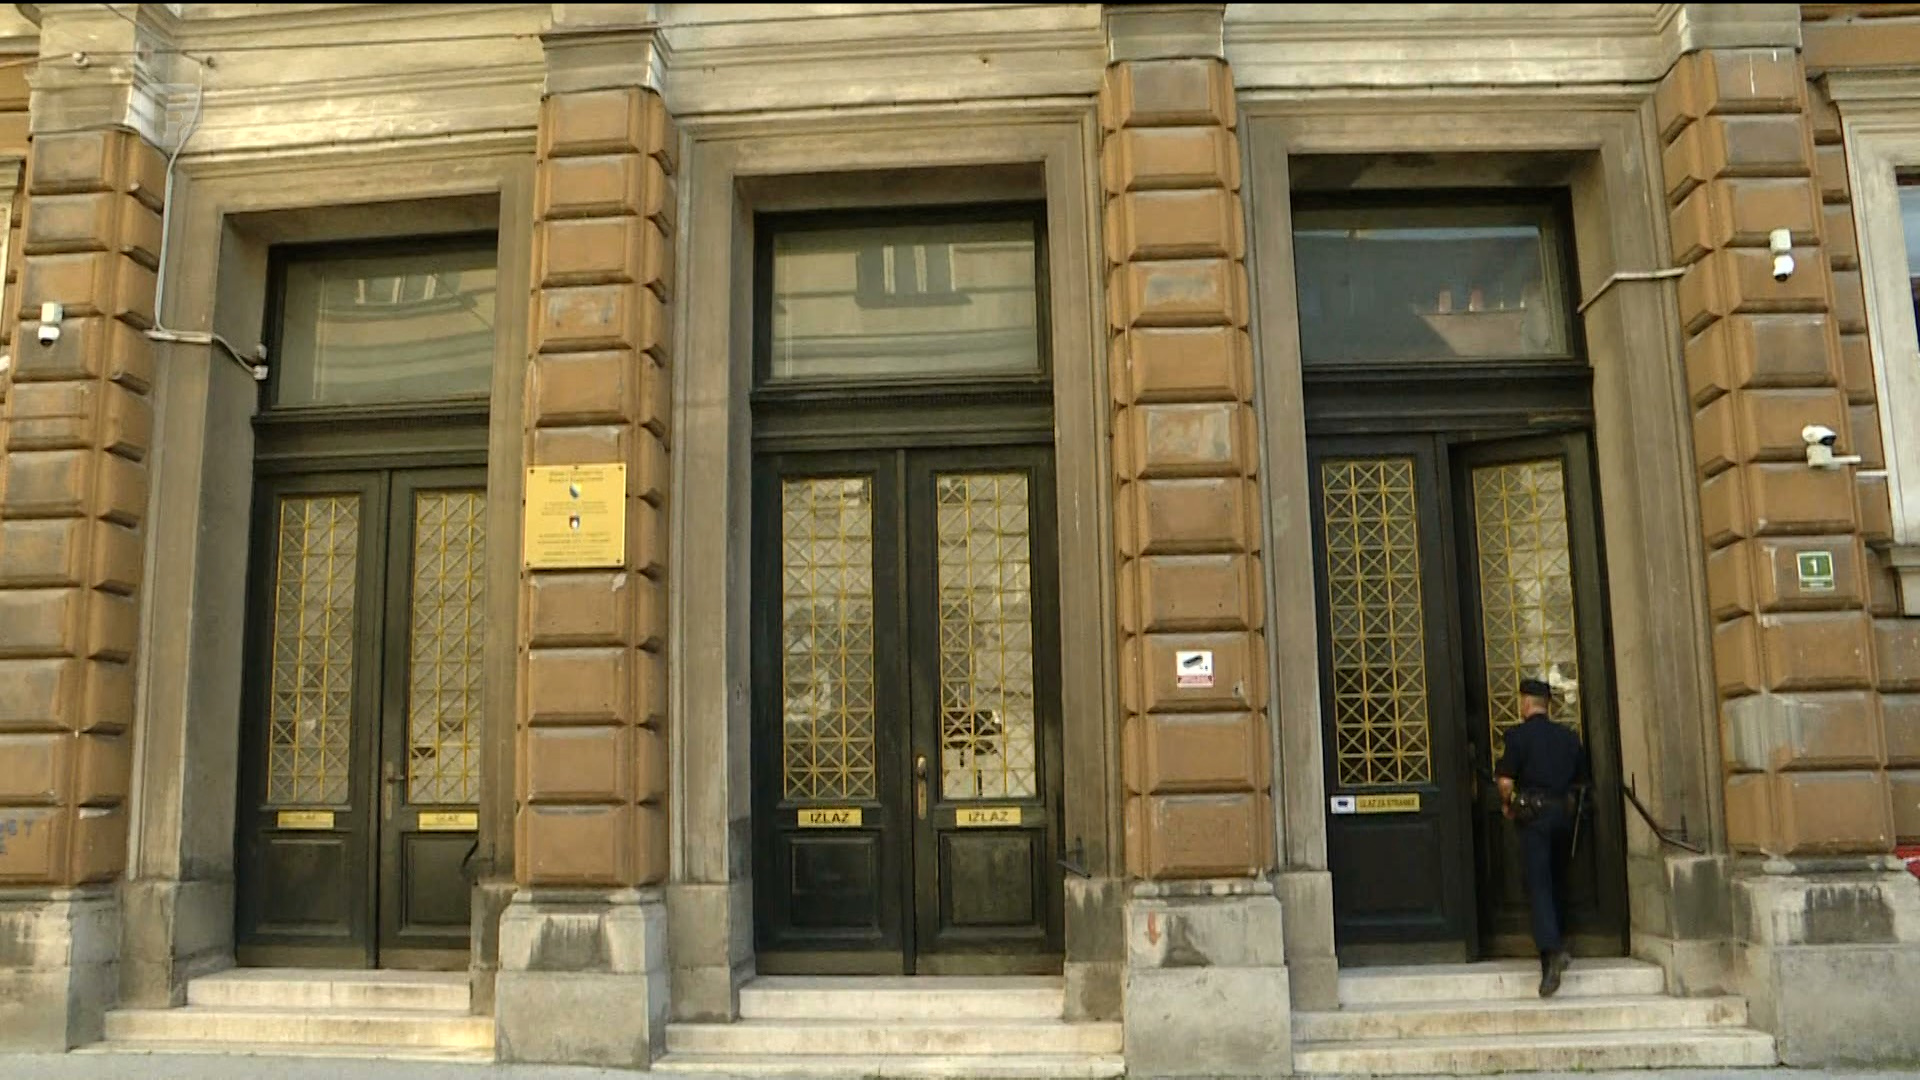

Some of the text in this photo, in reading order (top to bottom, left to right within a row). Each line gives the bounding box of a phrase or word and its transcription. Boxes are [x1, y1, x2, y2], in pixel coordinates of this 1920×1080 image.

[1809, 559, 1818, 574] 1
[810, 813, 849, 824] IZLAZ
[968, 811, 1009, 822] IZLAZ
